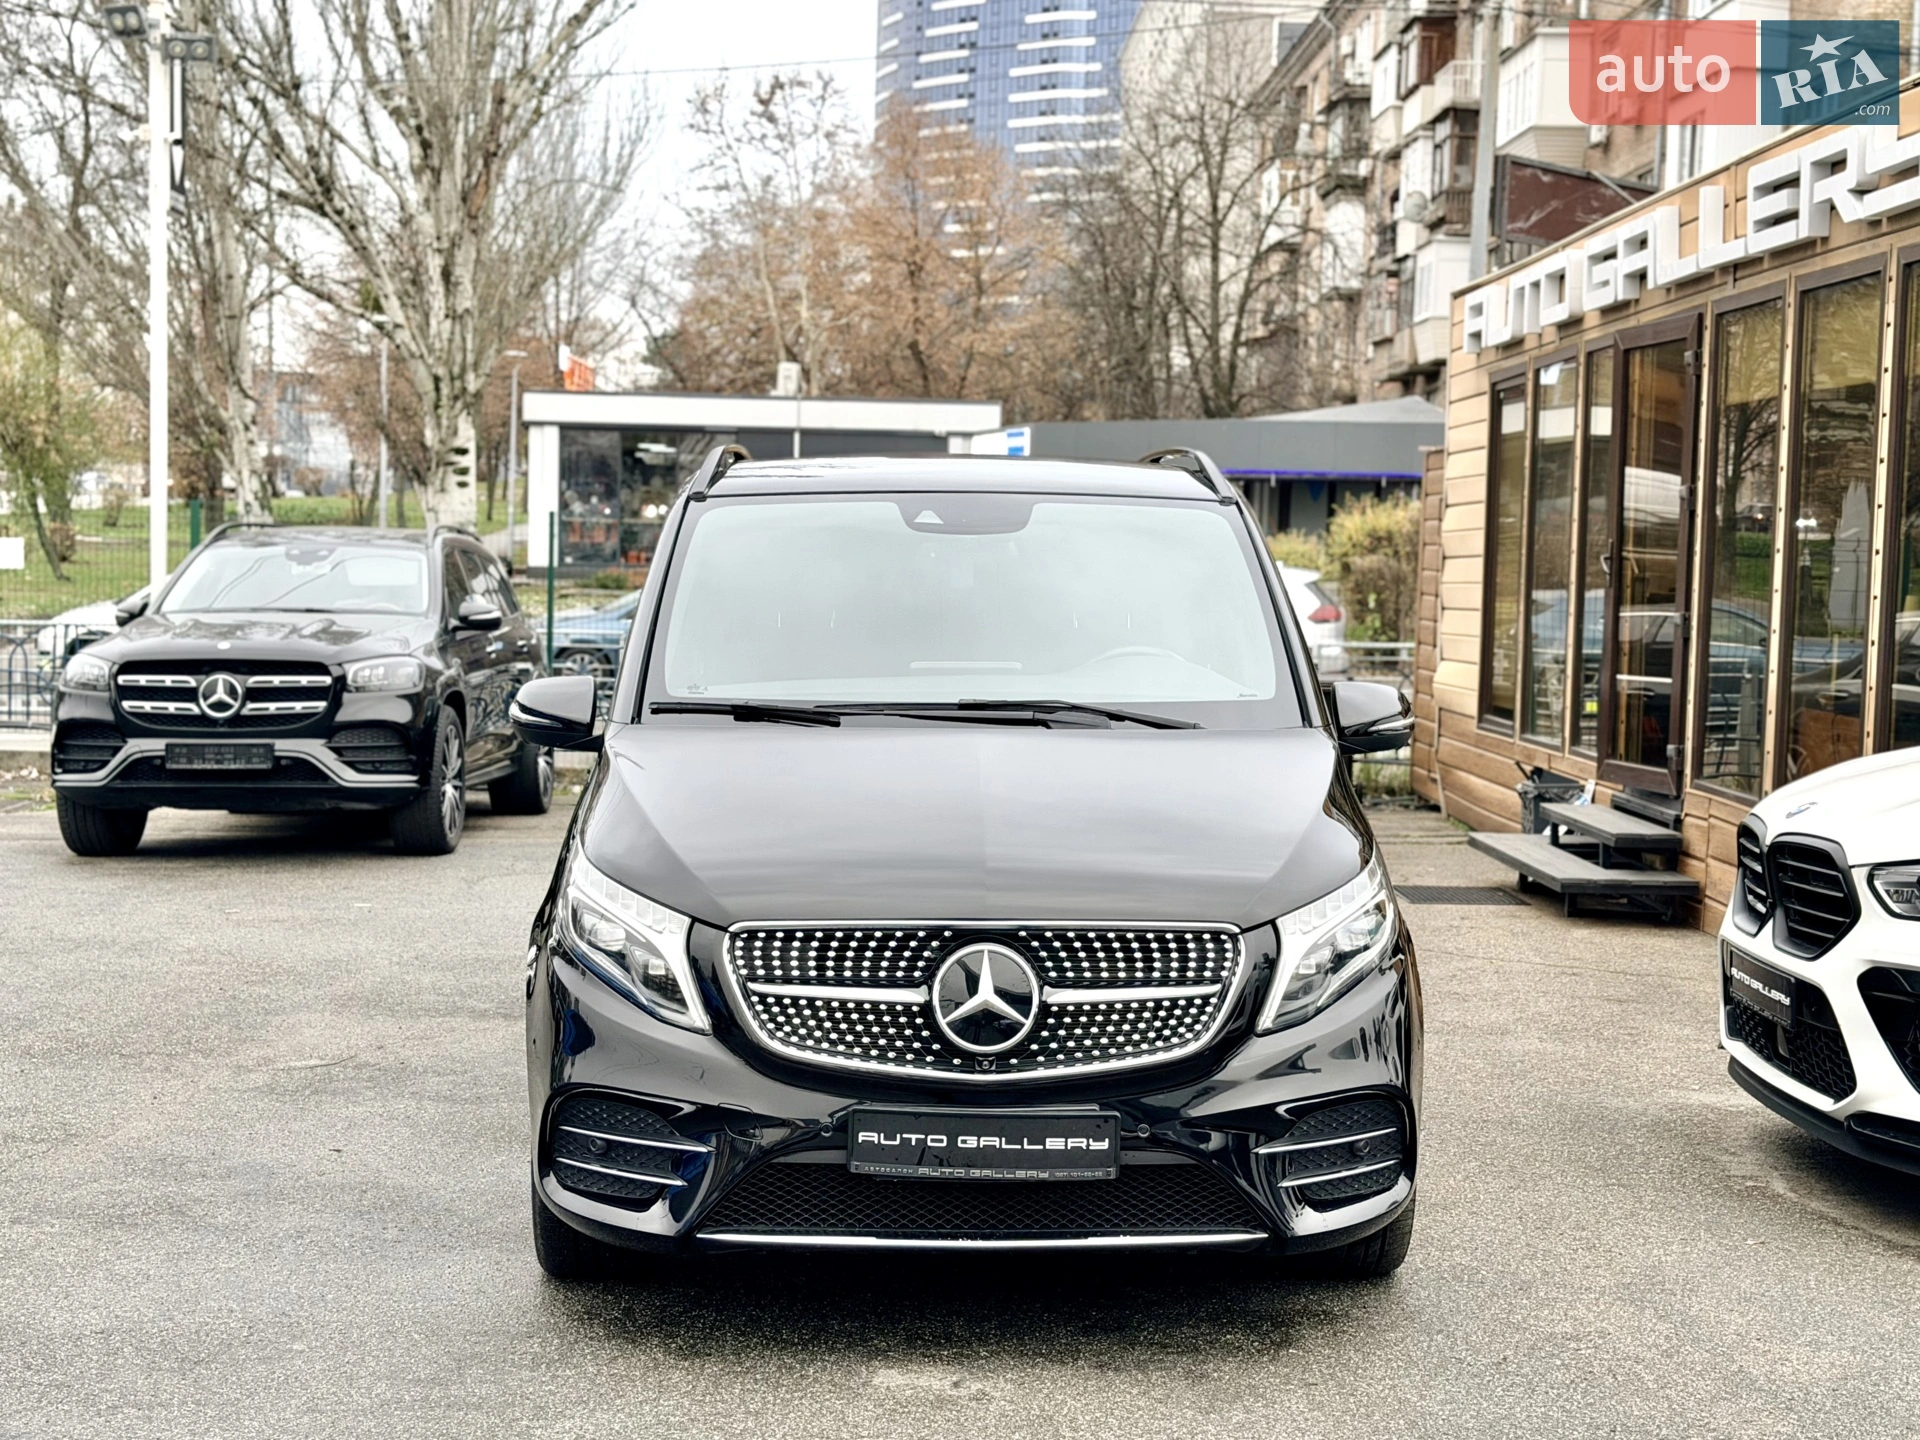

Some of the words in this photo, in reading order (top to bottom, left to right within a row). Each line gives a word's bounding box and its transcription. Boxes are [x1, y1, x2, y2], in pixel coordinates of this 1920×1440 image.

[1463, 247, 1584, 353] AUTO
[1731, 966, 1751, 986] AUTO
[1750, 978, 1790, 1006] GALLERY
[858, 1132, 948, 1148] AUTO
[957, 1135, 1110, 1150] GALLERY
[918, 1167, 965, 1177] AUTO
[969, 1169, 1049, 1179] GALLERY
